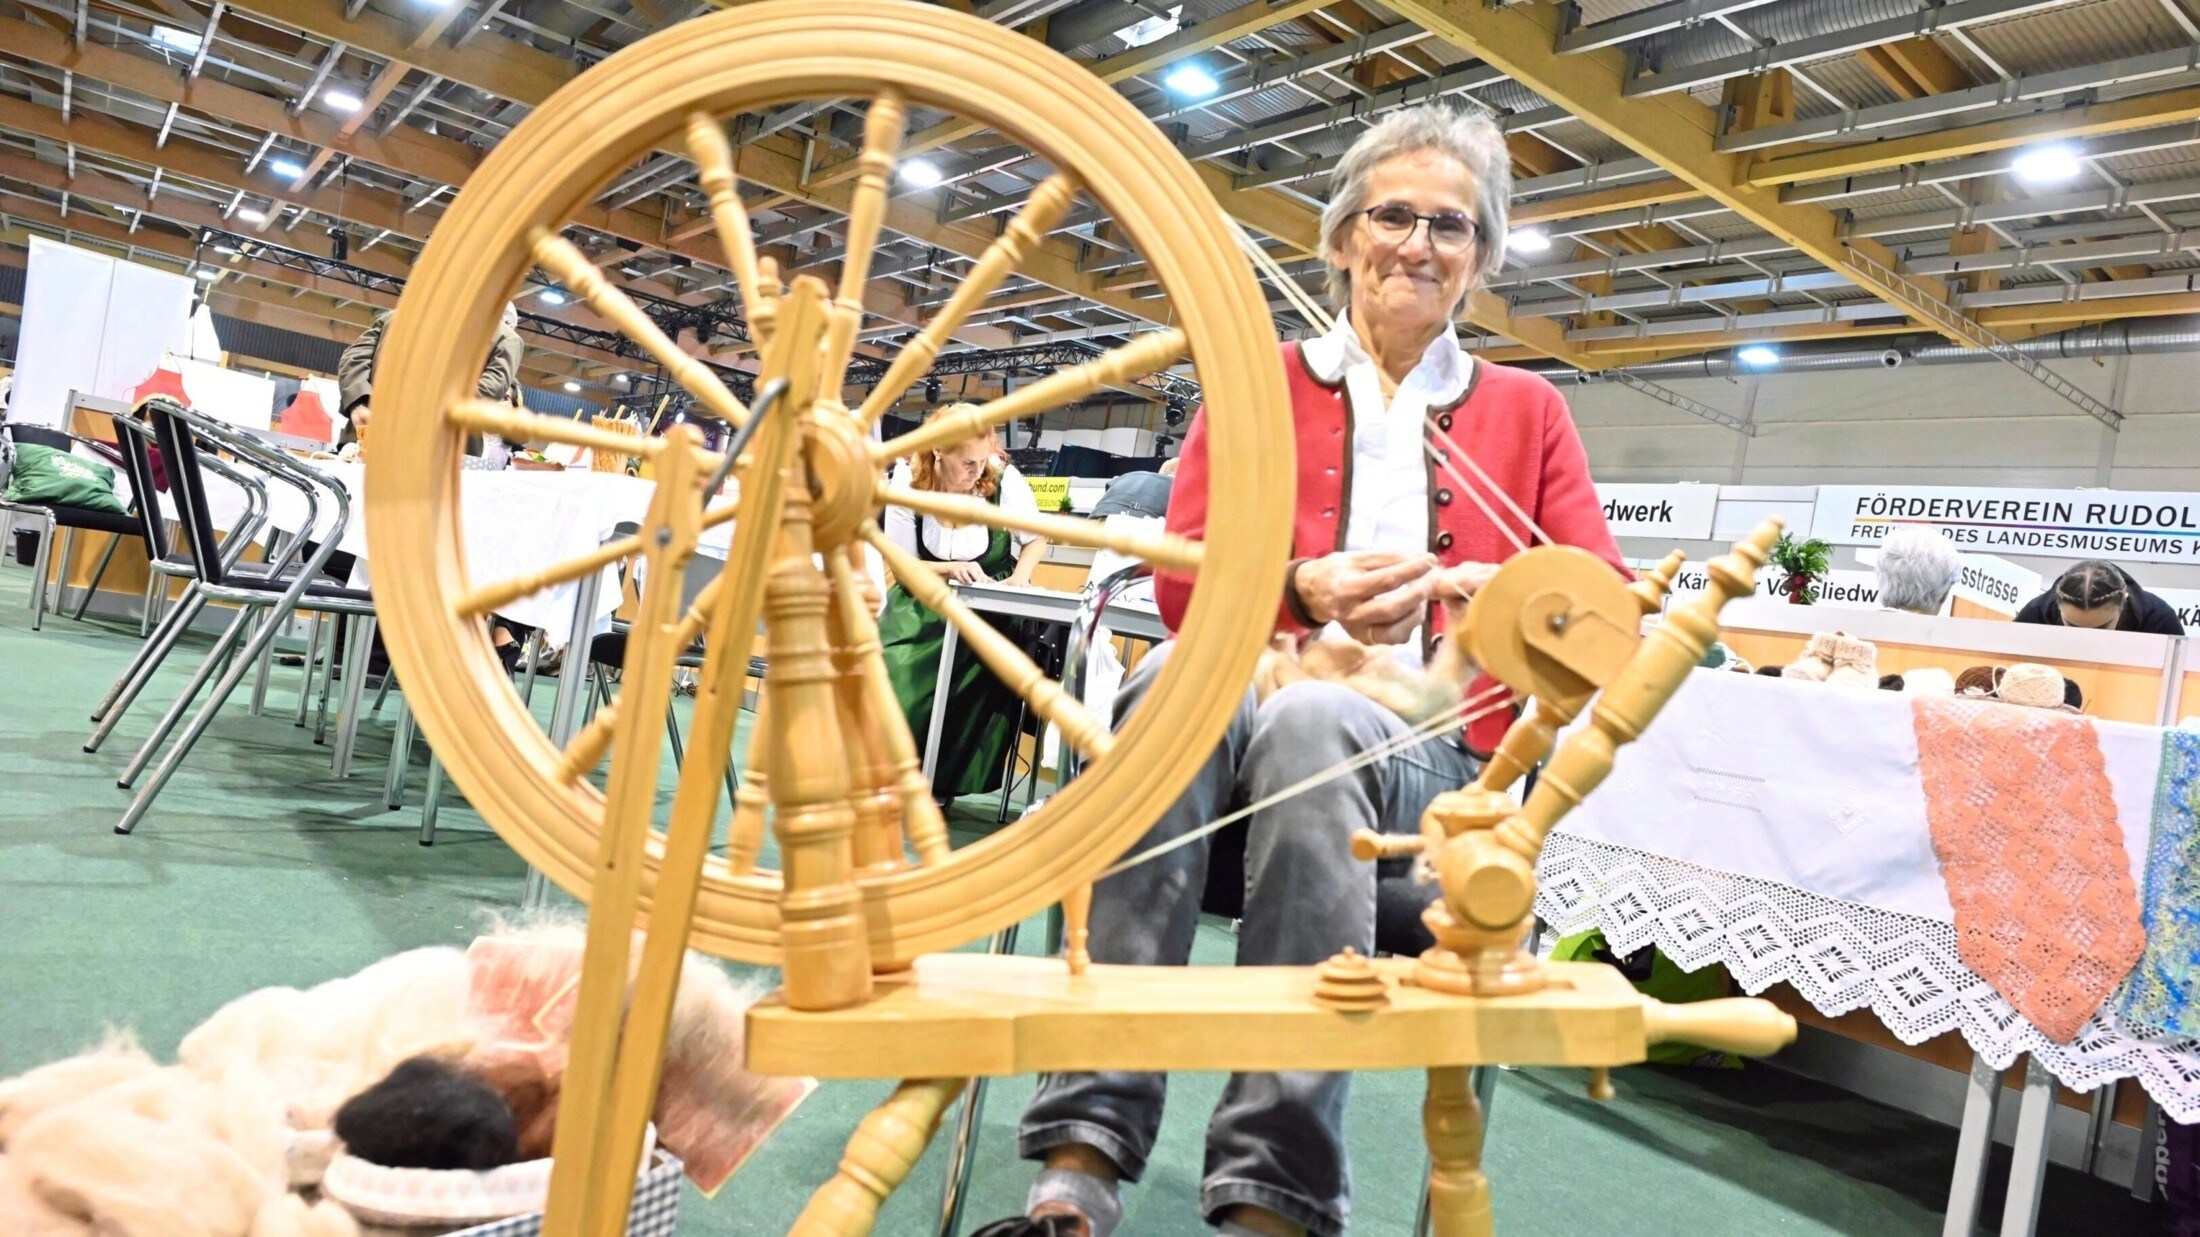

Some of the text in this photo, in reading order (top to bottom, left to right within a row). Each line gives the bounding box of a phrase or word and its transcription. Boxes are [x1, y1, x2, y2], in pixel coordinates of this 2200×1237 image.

[1029, 482, 1066, 493] und.com
[1603, 498, 1673, 522] dwerk
[1855, 493, 2197, 528] FÖRDERVEREIN RUDOL
[1986, 530, 2183, 555] LANDESMUSEUMS
[1767, 578, 1879, 604] Vosliedw
[1960, 566, 2019, 604] sstrasse
